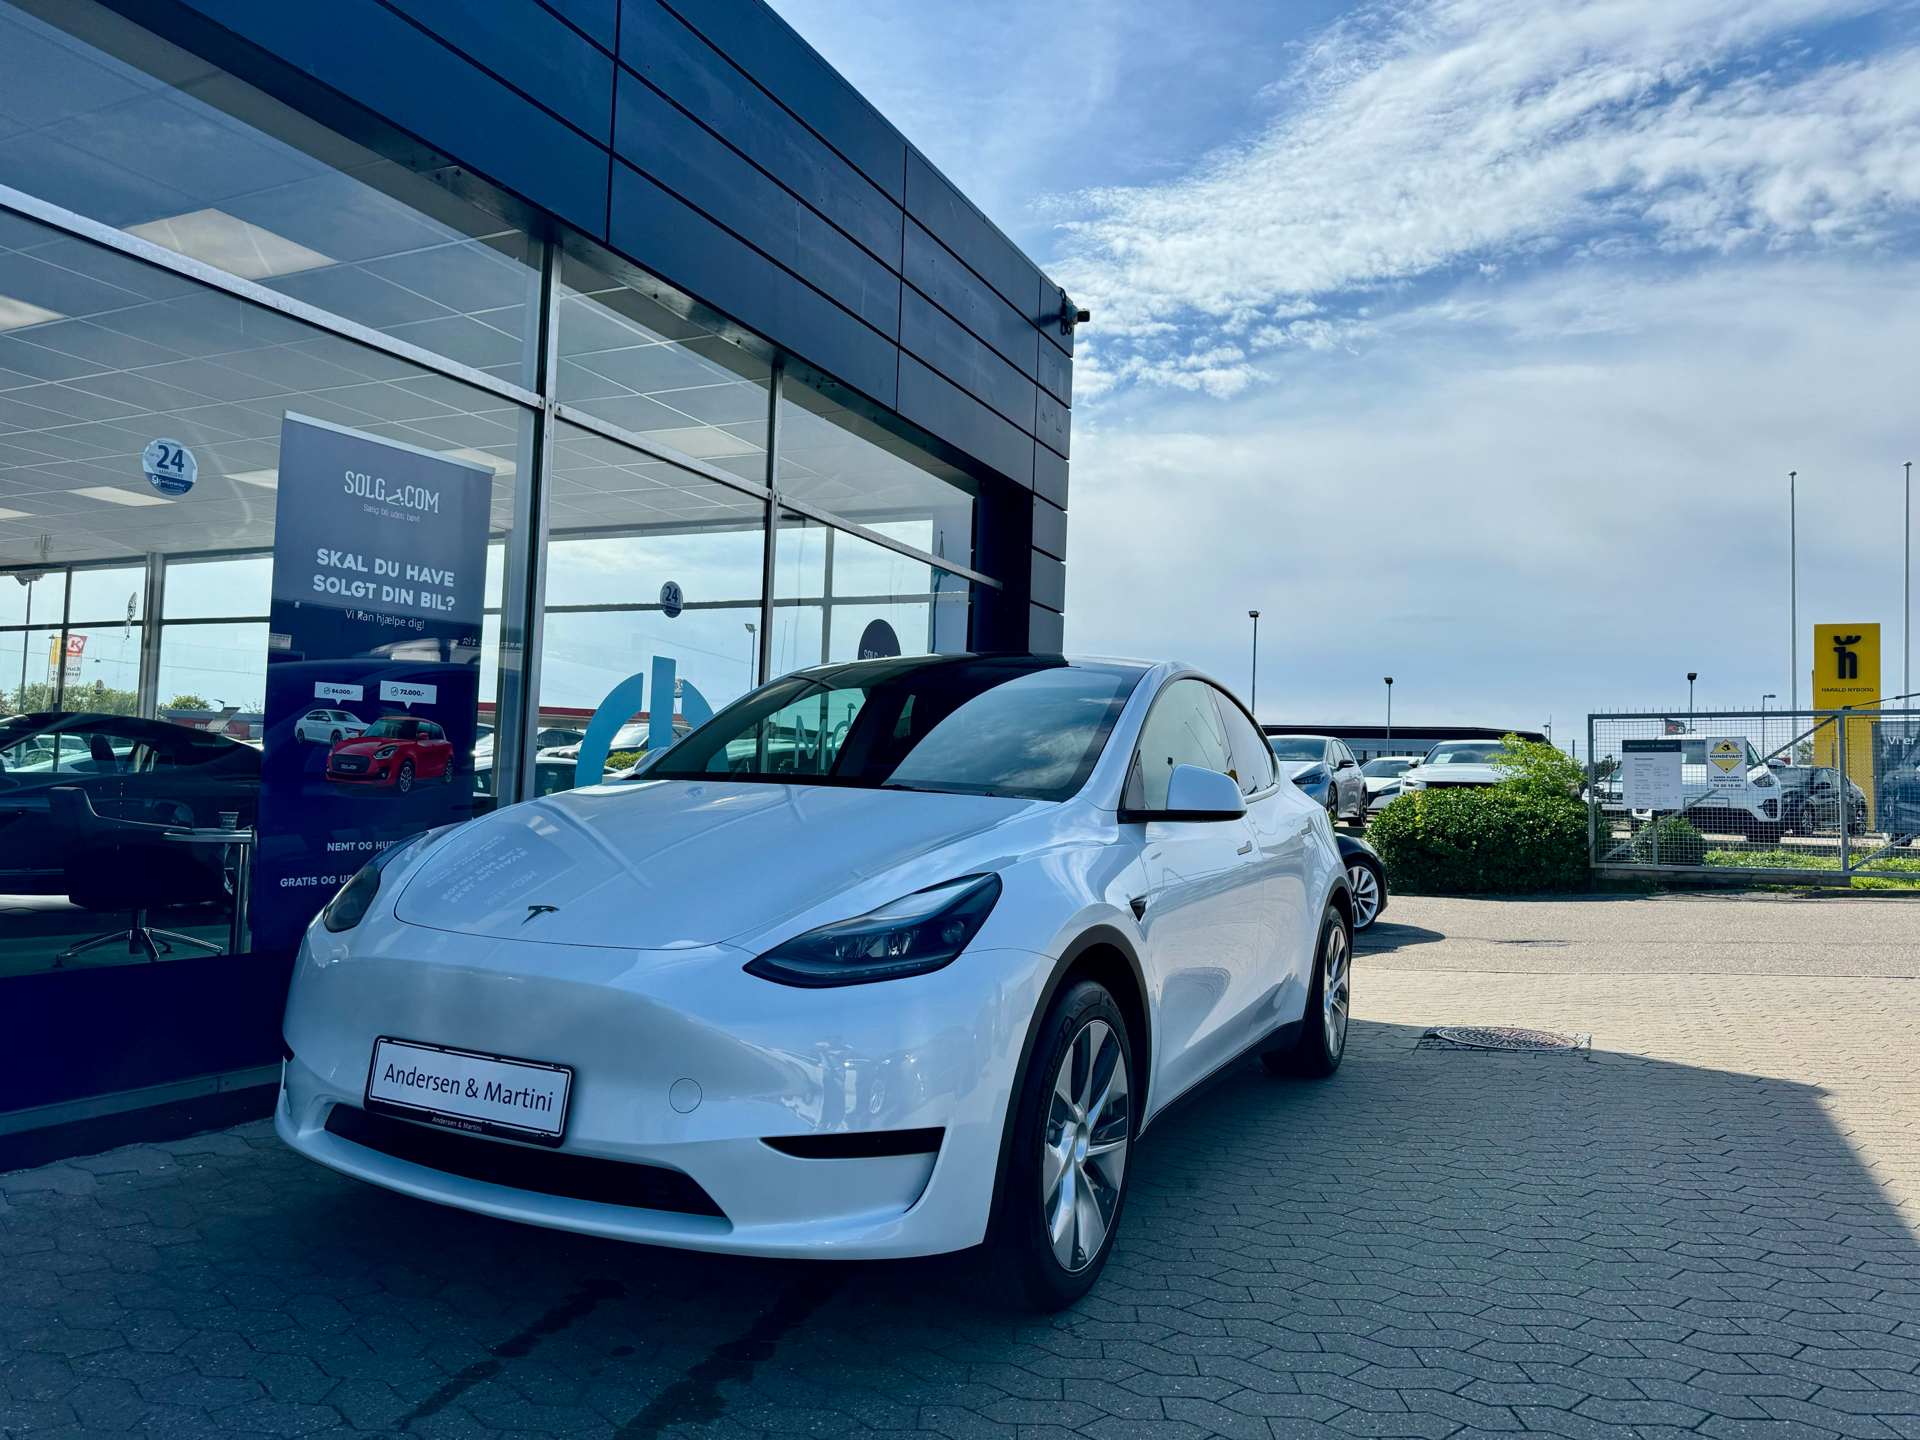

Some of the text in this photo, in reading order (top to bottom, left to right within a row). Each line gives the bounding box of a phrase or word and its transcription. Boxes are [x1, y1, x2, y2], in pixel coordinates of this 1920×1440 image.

[157, 445, 184, 472] 24
[363, 504, 379, 516] Sælg
[380, 508, 389, 516] bil
[390, 511, 405, 520] uden
[316, 548, 455, 587] SKAL DU HAVE
[313, 574, 456, 611] SOLGT DIN BIL?
[665, 586, 678, 603] 24
[345, 609, 355, 620] Vi
[376, 613, 406, 627] hjælpe
[408, 617, 425, 631] dig!
[400, 688, 425, 697] 72.000,-
[1887, 736, 1916, 745] Vi er
[327, 840, 398, 852] NEMT OG HUR
[280, 876, 318, 888] GRATIS
[320, 875, 336, 885] OG
[383, 1063, 554, 1112] Andersen & Martini
[432, 1116, 457, 1126] Andersen
[463, 1122, 483, 1132] Martini
